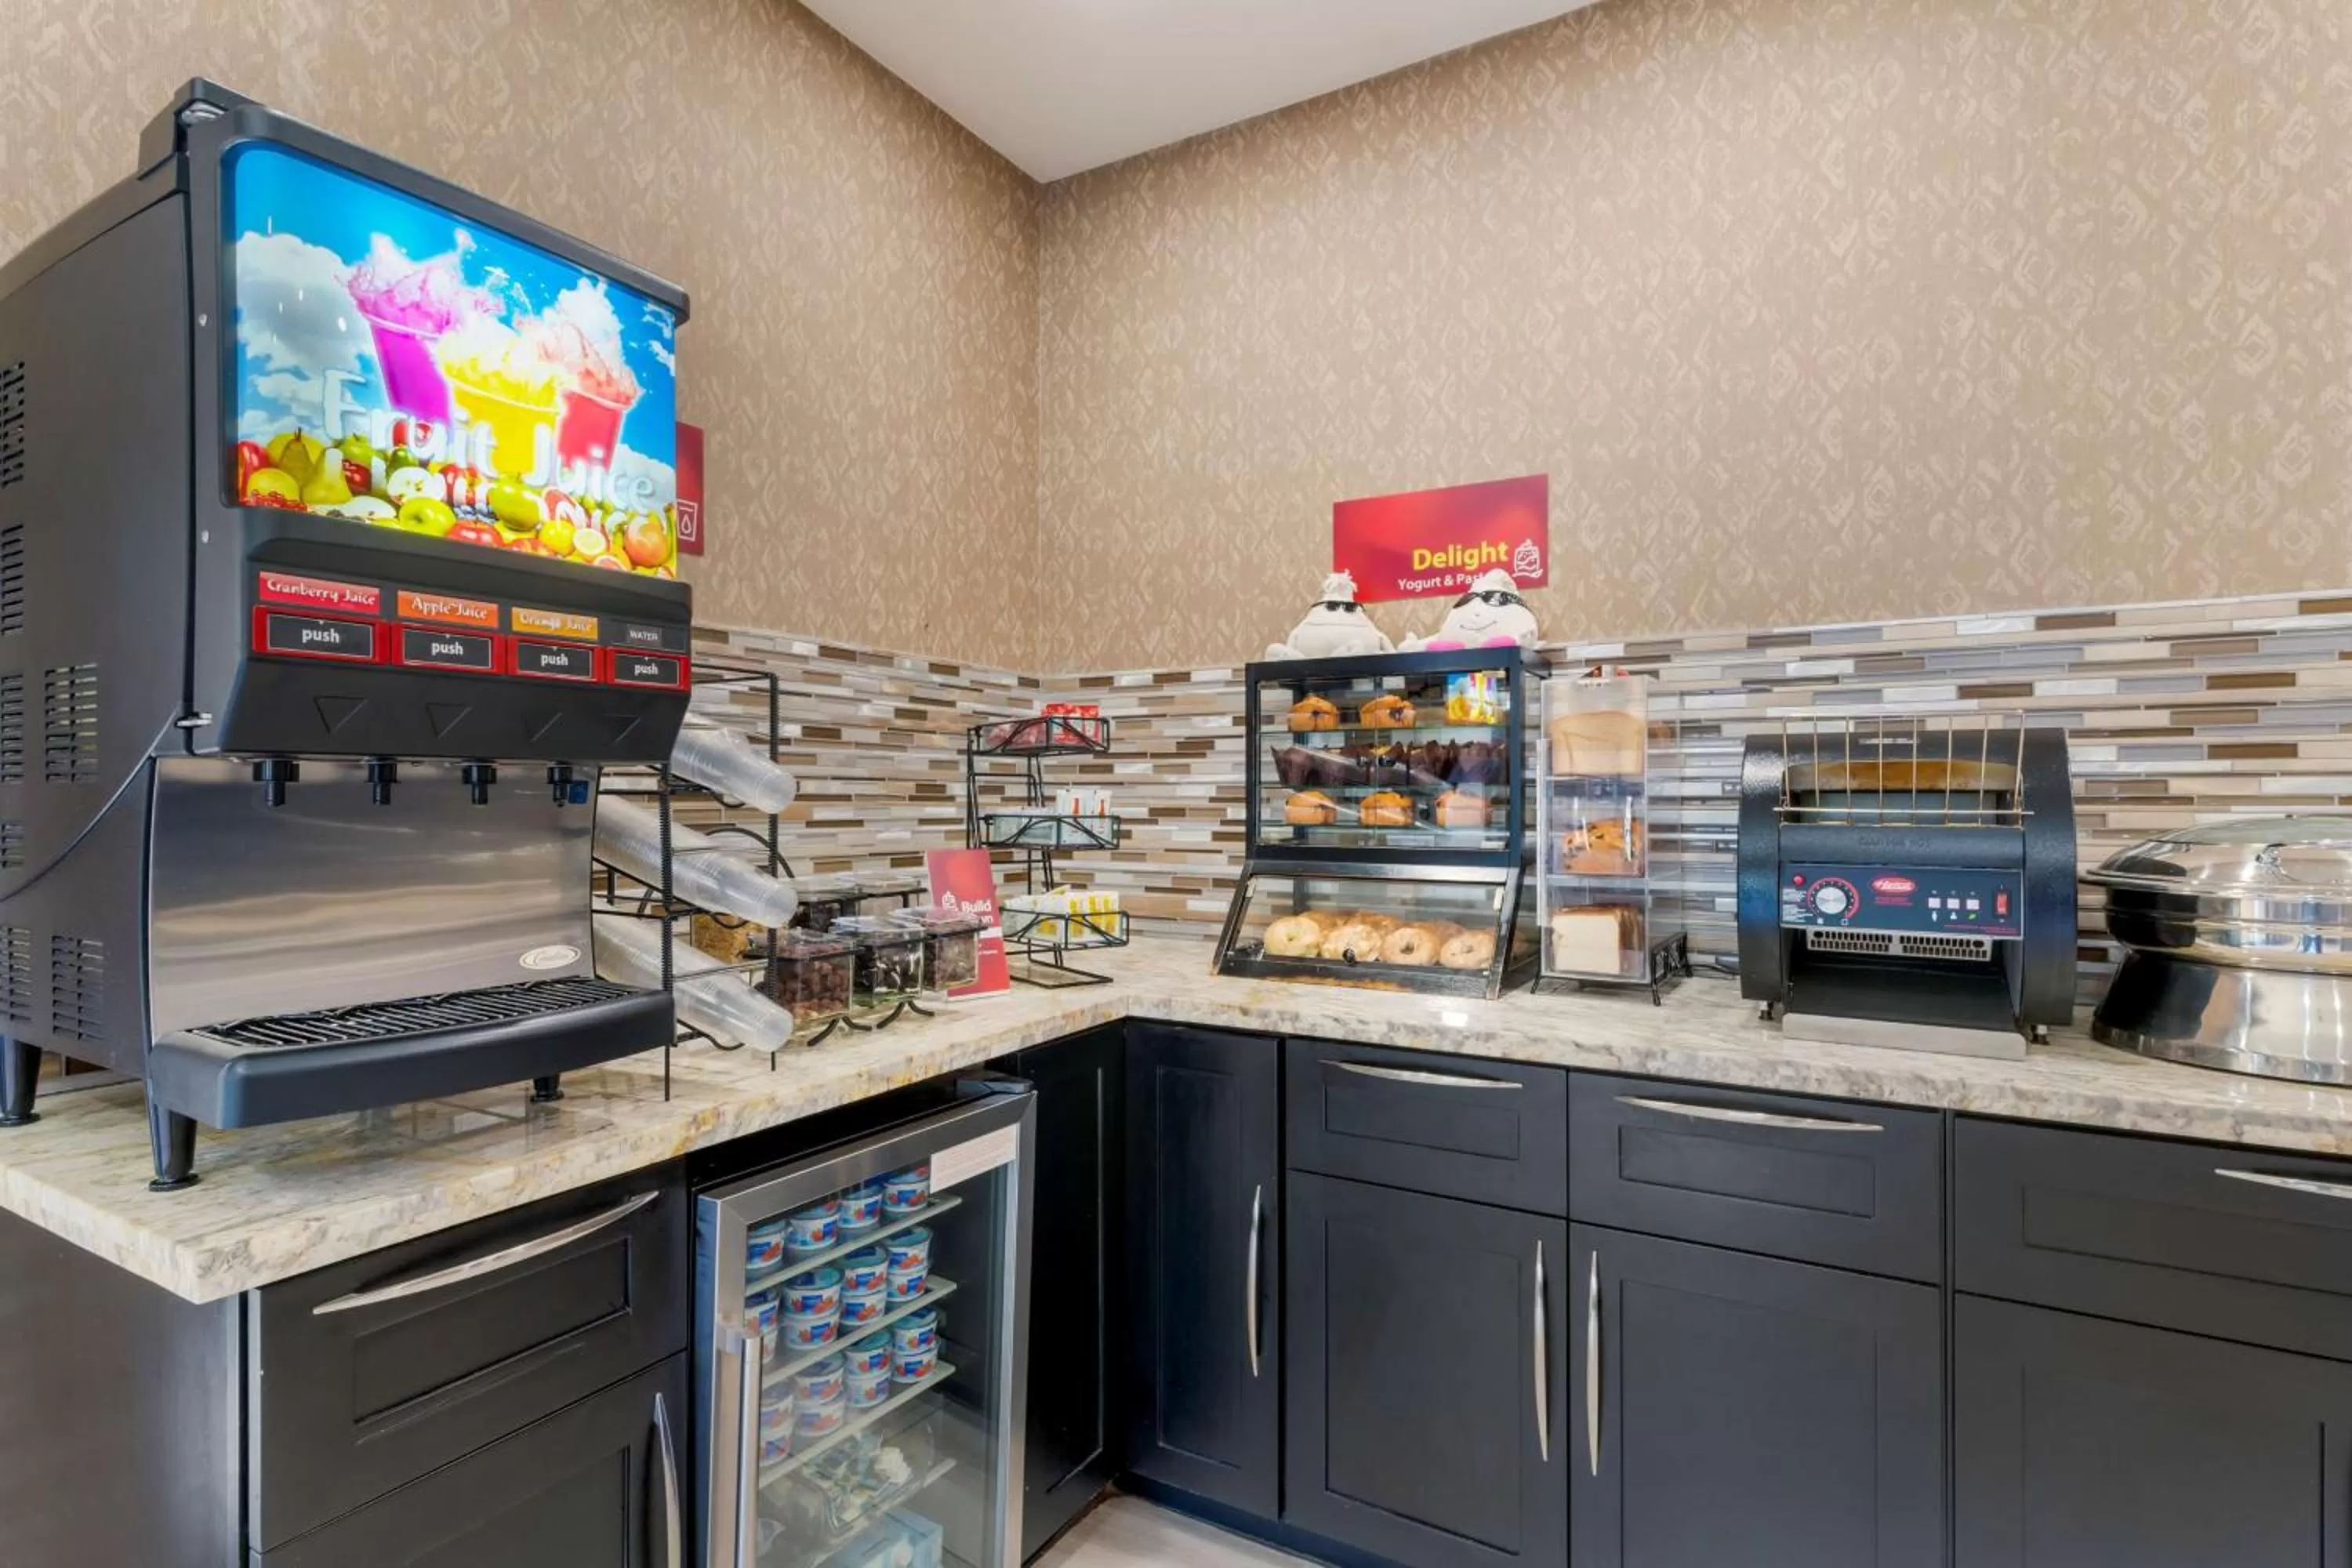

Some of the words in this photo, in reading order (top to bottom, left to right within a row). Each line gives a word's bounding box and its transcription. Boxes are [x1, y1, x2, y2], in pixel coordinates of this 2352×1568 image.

[324, 368, 498, 477] Fruit
[524, 422, 655, 514] Juice
[1414, 541, 1508, 571] Delight
[267, 578, 339, 603] Cranberry
[343, 587, 376, 605] Juice
[1398, 575, 1441, 593] Yogurt
[1443, 575, 1454, 586] &
[412, 595, 452, 615] Apple
[455, 603, 488, 619] Juice
[518, 611, 561, 630] Orange
[564, 617, 592, 631] Juice
[302, 628, 339, 644] push
[630, 630, 658, 641] WATER
[432, 641, 464, 656] push
[540, 652, 569, 666] push
[633, 663, 659, 677] push
[961, 899, 992, 913] Build
